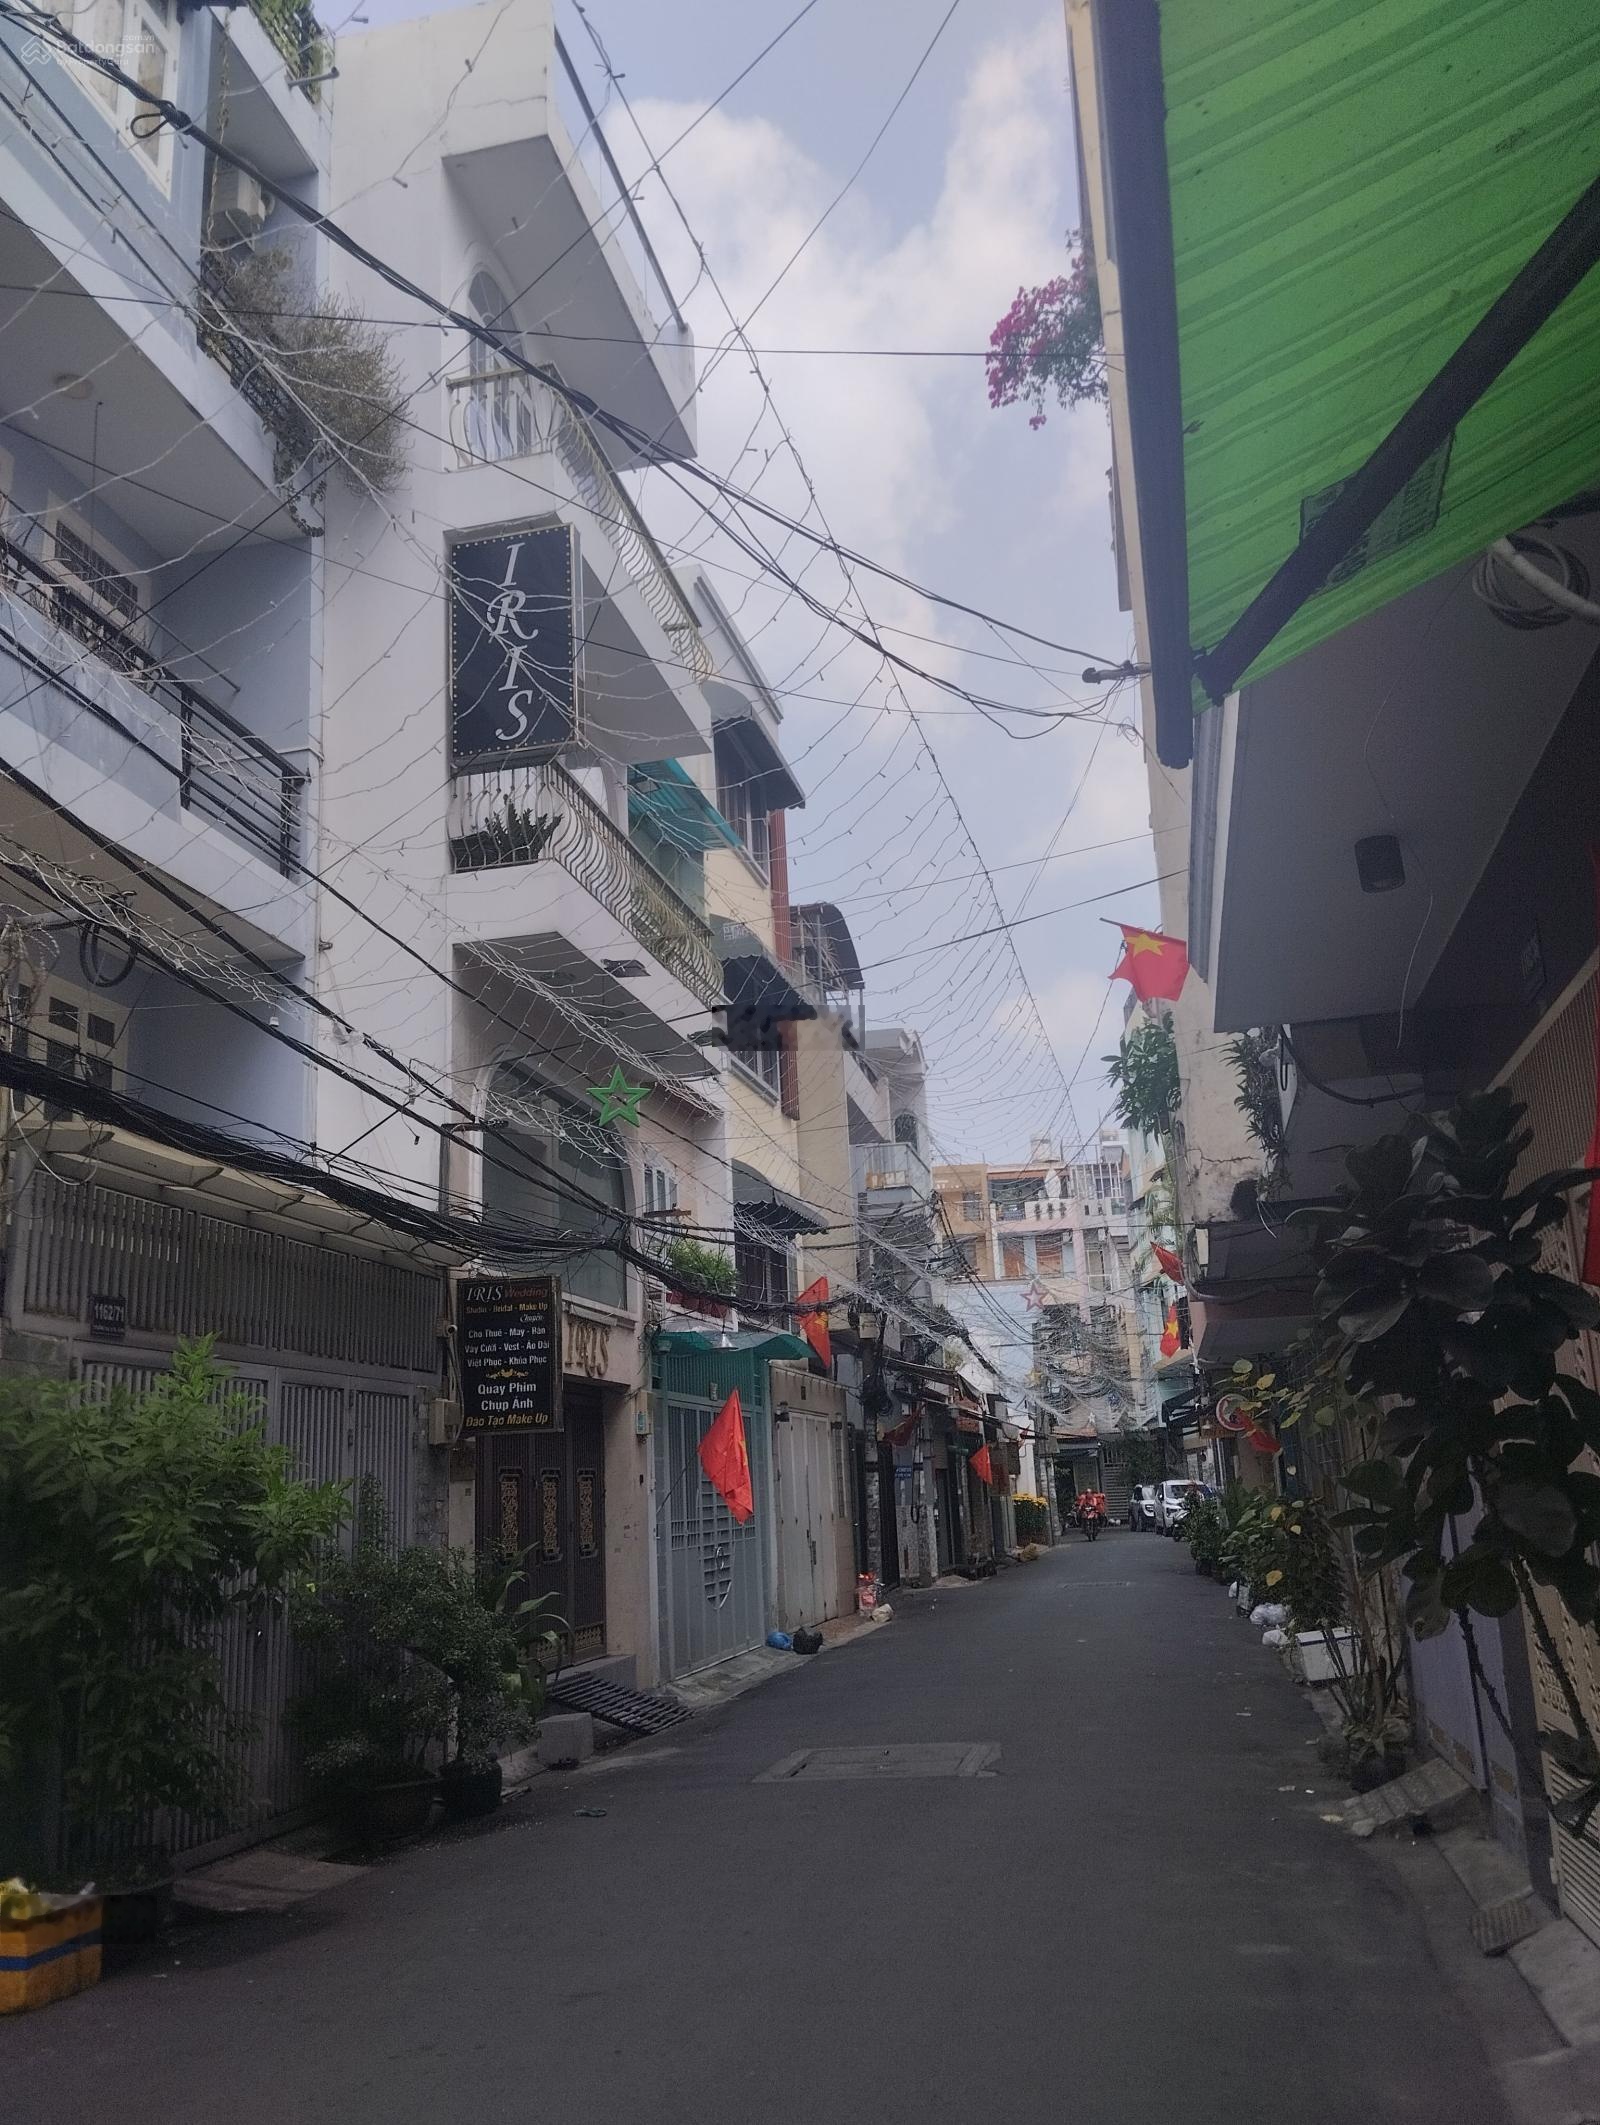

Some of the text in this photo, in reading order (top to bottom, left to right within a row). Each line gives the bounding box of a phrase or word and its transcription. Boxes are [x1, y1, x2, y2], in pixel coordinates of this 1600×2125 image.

[486, 542, 538, 741] IRIS
[466, 1285, 548, 1302] IRIS Wedding
[519, 1303, 538, 1311] Make
[538, 1302, 548, 1311] Up
[468, 1329, 483, 1339] Cho
[509, 1328, 525, 1337] May
[504, 1342, 520, 1351] Vest
[565, 1321, 610, 1378] IRIS
[477, 1382, 537, 1396] Quay Phim
[481, 1400, 509, 1412] Chụp
[487, 1415, 505, 1428] Tạo
[506, 1413, 533, 1425] Make
[535, 1412, 549, 1425] Up
